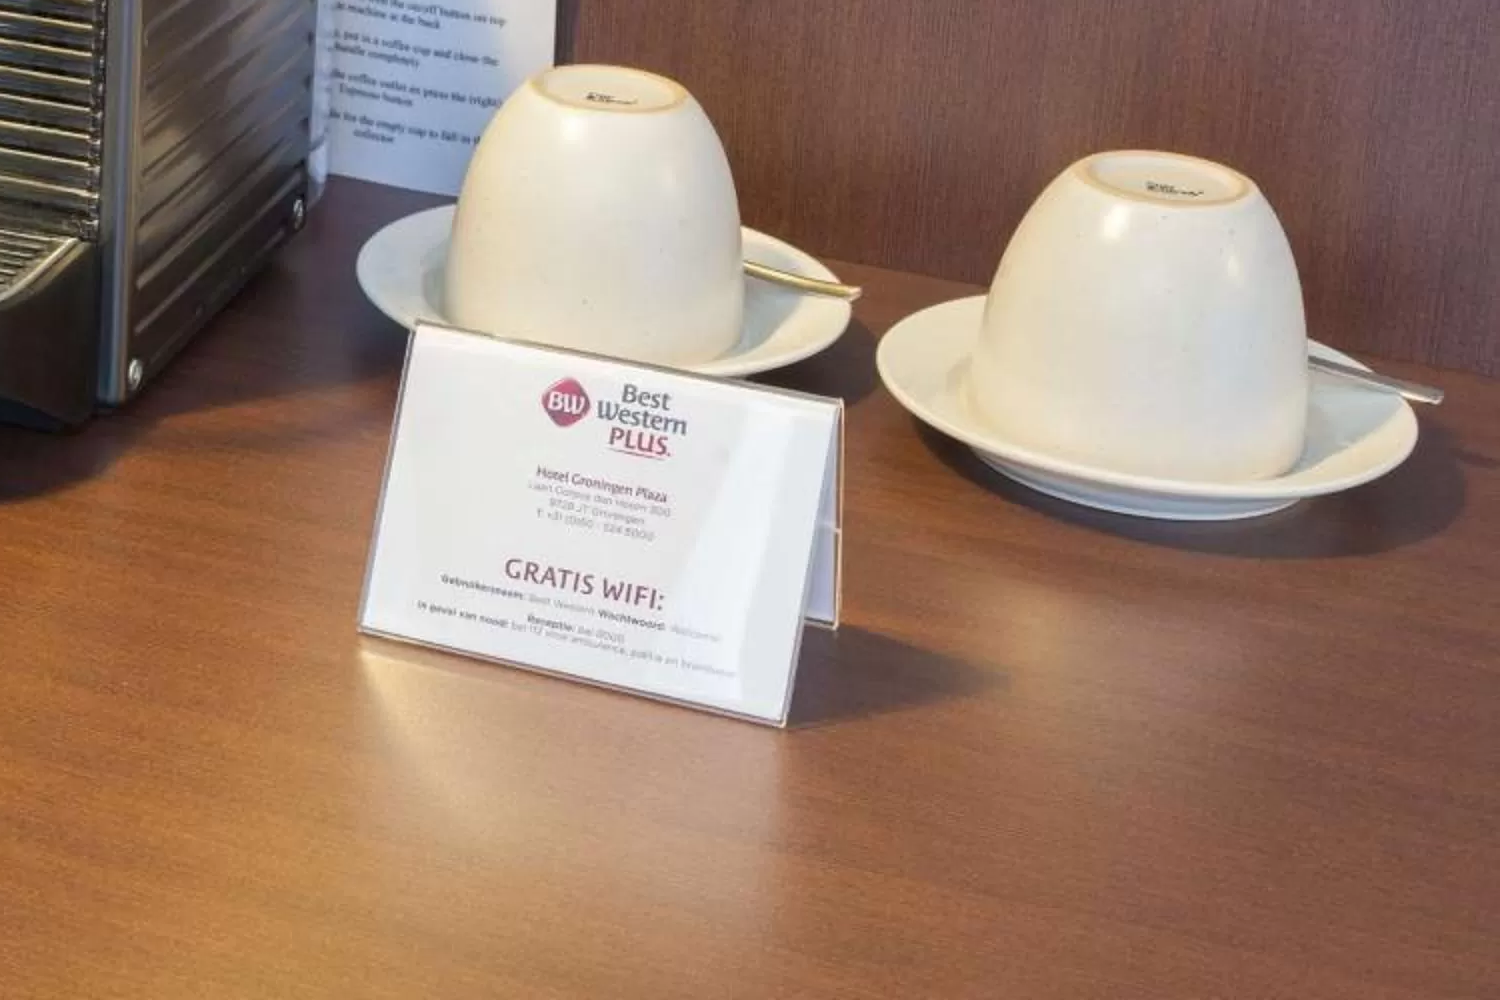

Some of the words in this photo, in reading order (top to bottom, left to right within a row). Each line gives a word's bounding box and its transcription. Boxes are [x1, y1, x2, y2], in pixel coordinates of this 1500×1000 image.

[548, 391, 585, 414] BW
[622, 383, 671, 411] Best
[596, 400, 687, 436] Western
[536, 465, 569, 483] Hotel
[572, 474, 633, 496] Groningen
[635, 486, 667, 502] Plaza
[505, 558, 594, 597] GRATIS
[602, 579, 665, 611] WIFI:
